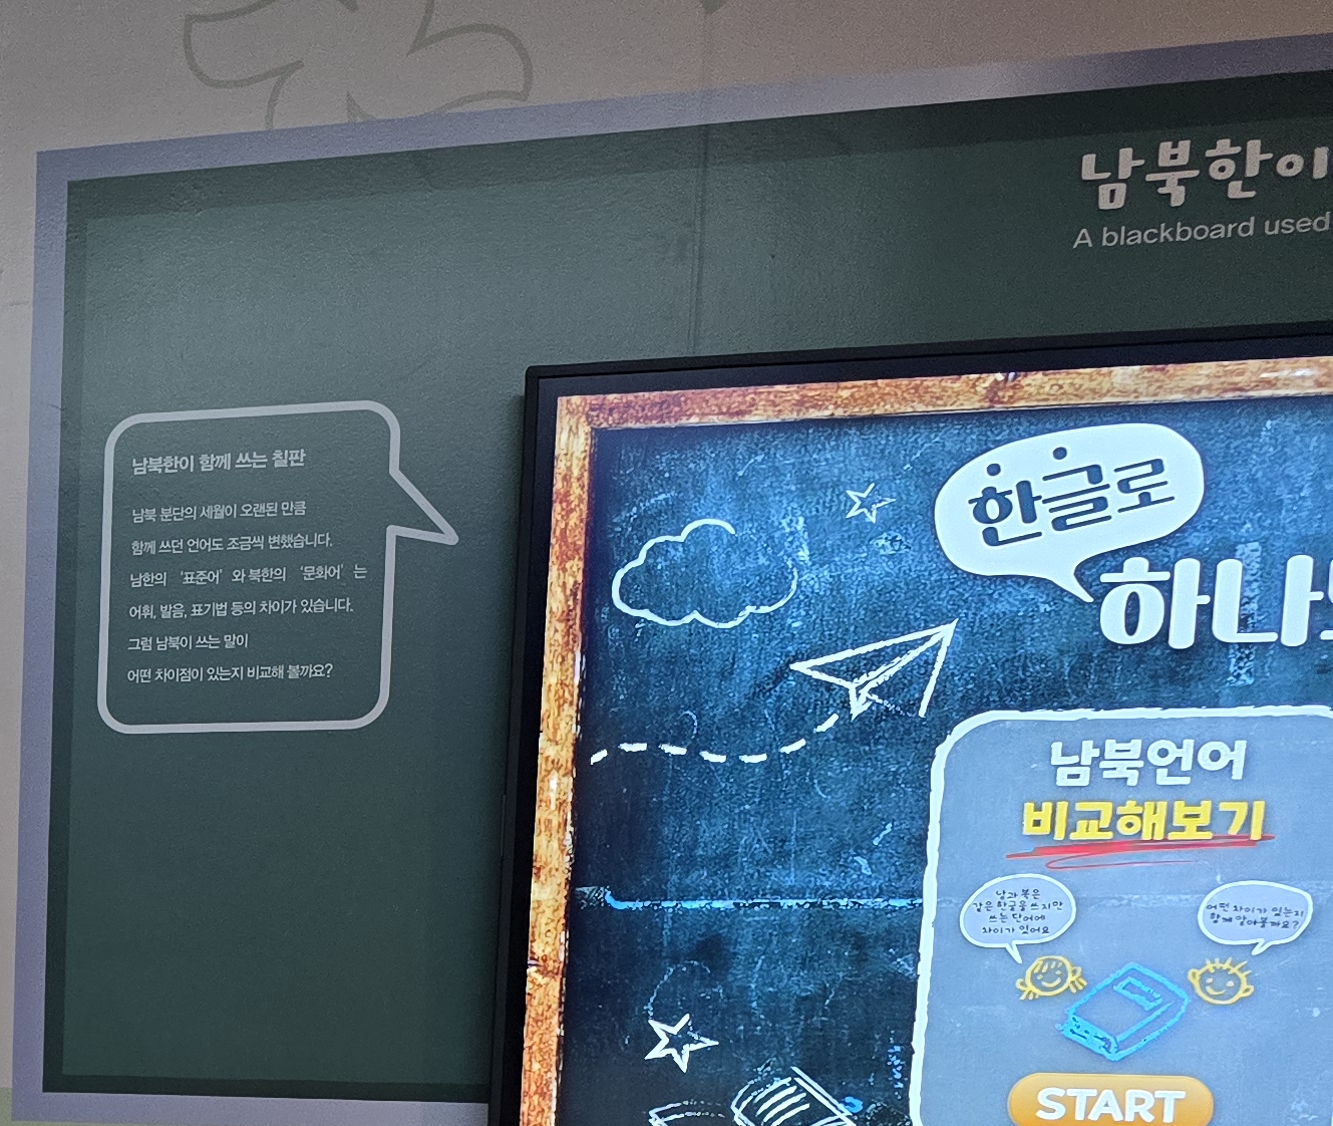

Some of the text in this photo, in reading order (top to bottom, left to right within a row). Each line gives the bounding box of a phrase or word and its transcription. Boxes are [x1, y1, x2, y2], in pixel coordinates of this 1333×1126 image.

[1081, 138, 1330, 209] 남북한이
[1072, 211, 1331, 249] A blackboard used
[132, 449, 306, 475] 남북한이 함께 쓰는 칠판
[132, 508, 157, 523] 남북
[159, 506, 197, 522] 분단의
[199, 503, 237, 519] 세월이
[281, 501, 307, 516] 만큼
[968, 447, 1175, 547] 한글로
[131, 532, 333, 556] 함께 쓰던 언어도 조금씩 변했습니다.
[130, 572, 167, 588] 남한의
[231, 569, 246, 583] 와
[248, 567, 286, 583] 북한의
[353, 564, 368, 579] 는
[129, 598, 354, 620] 어휘, 발음, 표기법 등의 차이가 있습니다.
[1099, 555, 1333, 649] 하나
[128, 634, 249, 651] 그럼 남북이 쓰는 말이
[127, 663, 334, 683] 어떤 차이점이 있는지 비교해 볼까요?
[1051, 738, 1247, 786] 남북언어
[1022, 800, 1266, 840] 비교해보기
[1035, 1087, 1186, 1123] START
